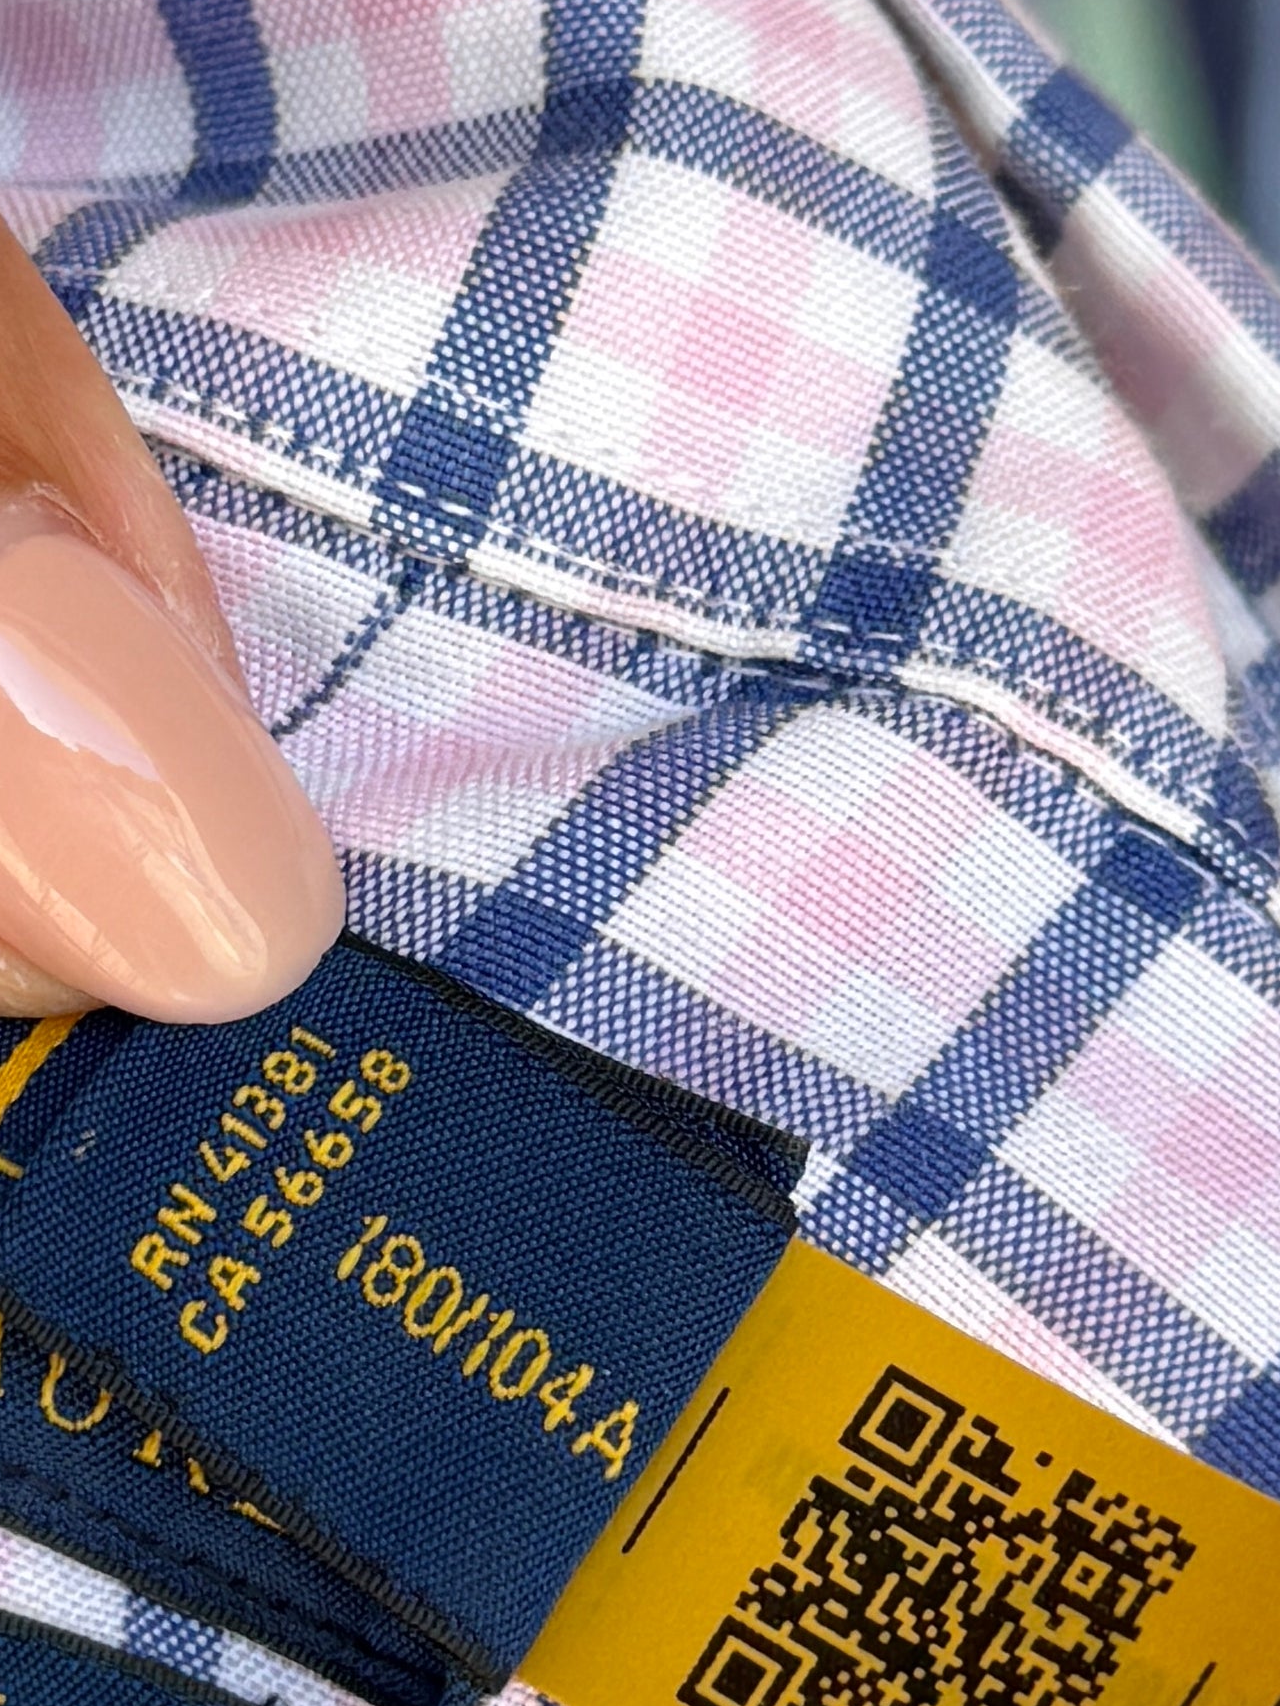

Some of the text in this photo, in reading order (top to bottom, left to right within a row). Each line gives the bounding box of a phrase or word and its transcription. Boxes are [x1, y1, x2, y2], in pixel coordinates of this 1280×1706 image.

[129, 1026, 336, 1292] RN 41381
[178, 1048, 413, 1355] CA 56658
